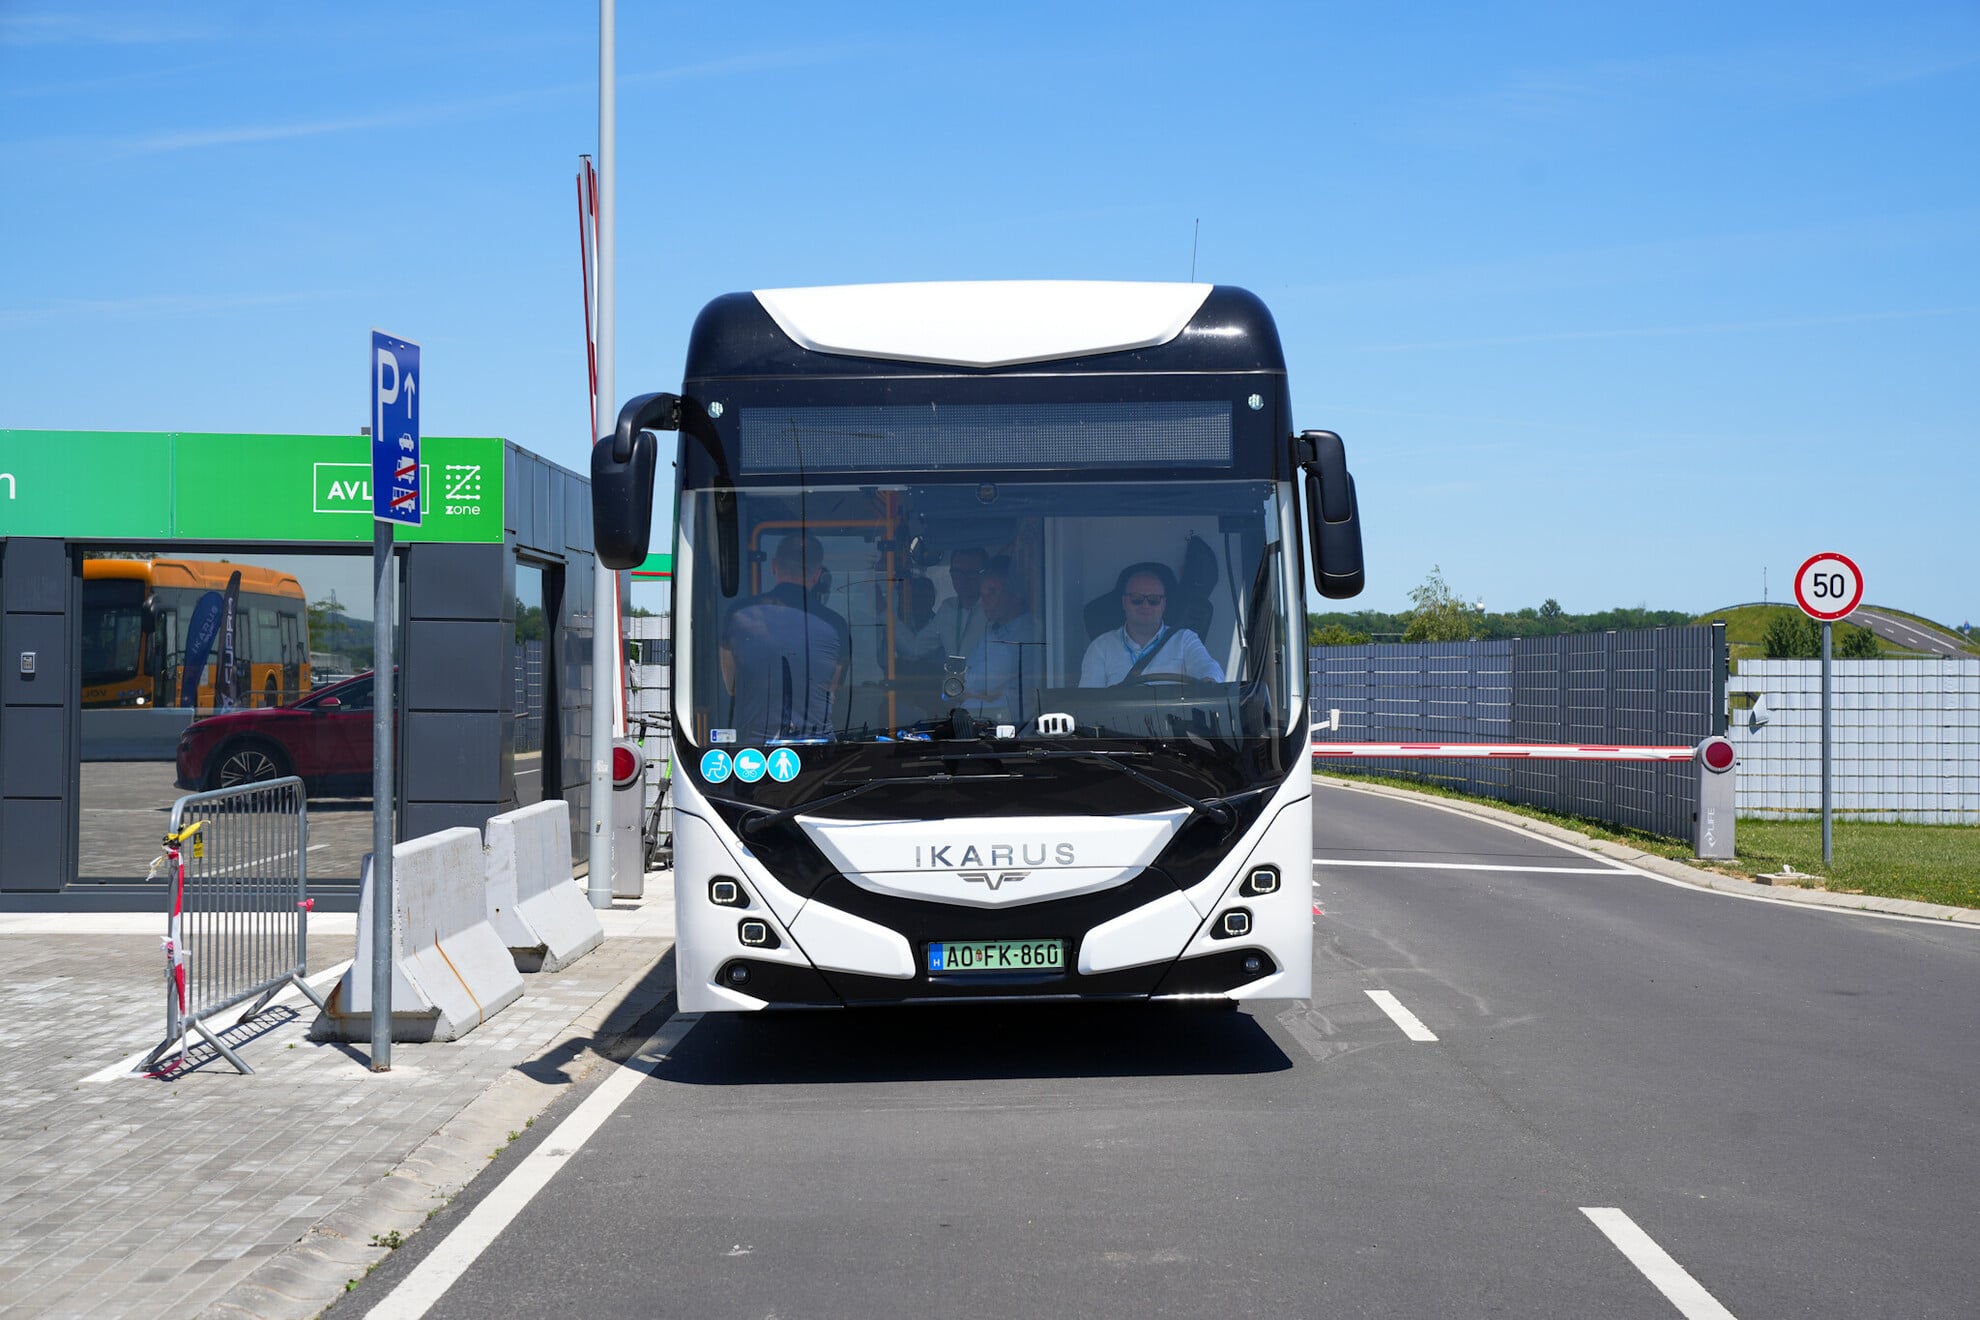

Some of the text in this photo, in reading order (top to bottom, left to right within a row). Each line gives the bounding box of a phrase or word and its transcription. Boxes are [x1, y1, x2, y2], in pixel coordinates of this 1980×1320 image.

[378, 348, 400, 442] P
[445, 505, 481, 515] zone
[1813, 573, 1845, 599] 50
[225, 597, 234, 684] CUPRA
[1707, 807, 1715, 831] LIFE
[915, 843, 1075, 868] IKARUS
[933, 959, 941, 967] H
[984, 944, 1058, 967] FK-860
